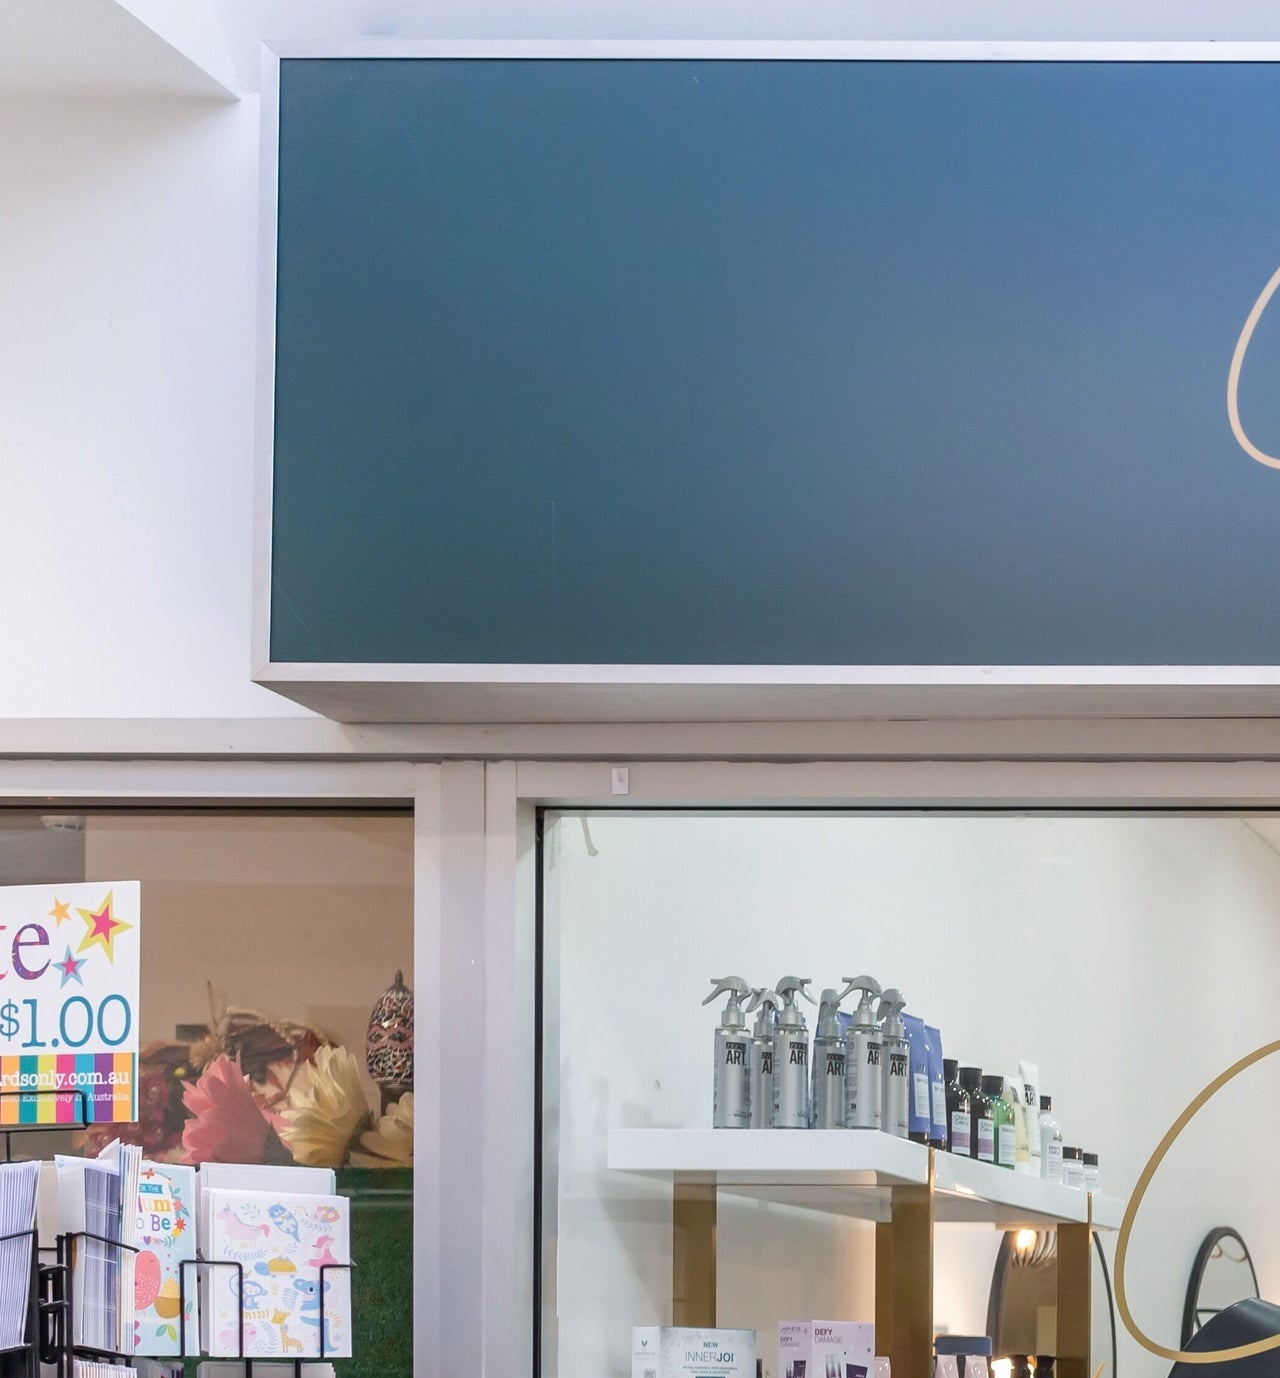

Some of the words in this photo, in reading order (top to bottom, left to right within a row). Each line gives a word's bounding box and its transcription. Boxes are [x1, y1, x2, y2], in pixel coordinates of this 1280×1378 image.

[0, 994, 132, 1048] $1.00
[867, 1050, 881, 1065] AR
[88, 1091, 130, 1102] Australia
[150, 1213, 171, 1232] Be
[814, 1328, 834, 1336] DEFY
[703, 1341, 720, 1349] NEW
[685, 1351, 735, 1363] INNERJOI
